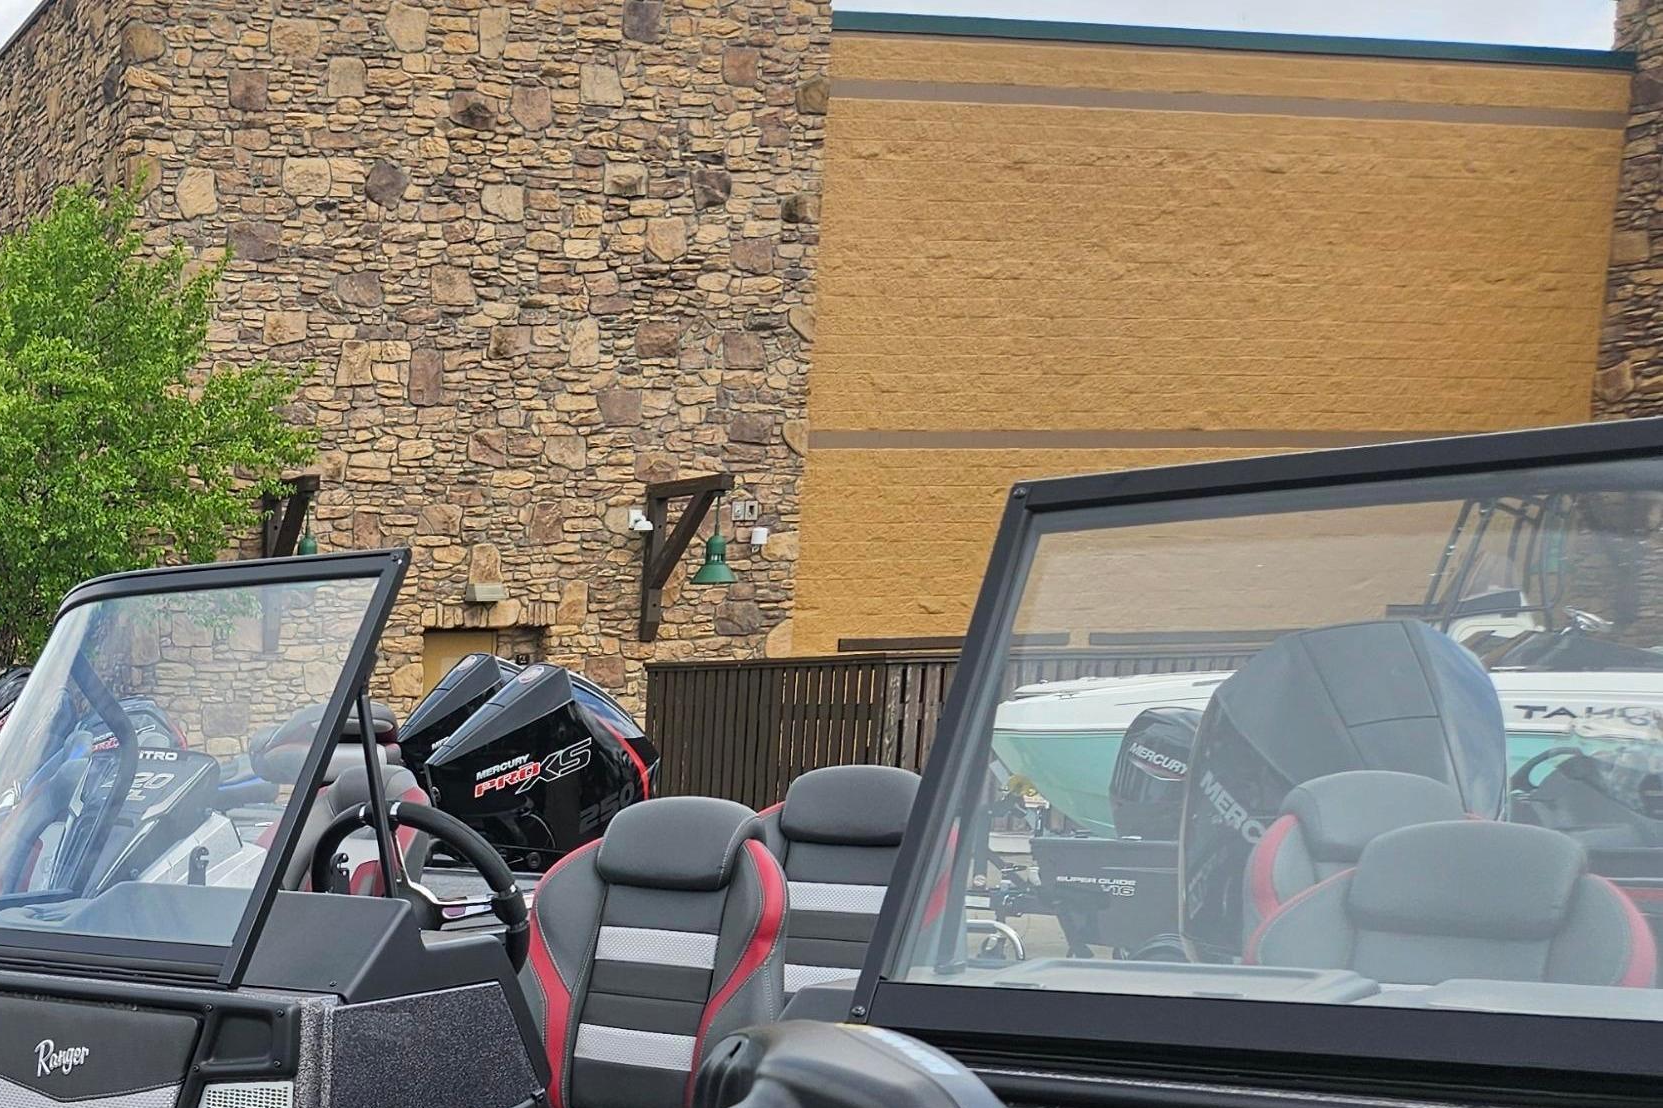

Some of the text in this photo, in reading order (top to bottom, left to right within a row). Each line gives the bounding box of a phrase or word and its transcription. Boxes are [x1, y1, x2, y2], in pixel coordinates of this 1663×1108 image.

[138, 751, 178, 761] ITRO
[476, 753, 530, 780] MERCURY
[1129, 742, 1188, 775] MERCURY
[579, 783, 635, 834] 250
[1200, 769, 1264, 844] MERC
[1100, 884, 1135, 897] V16
[34, 1039, 90, 1077] Ranger
